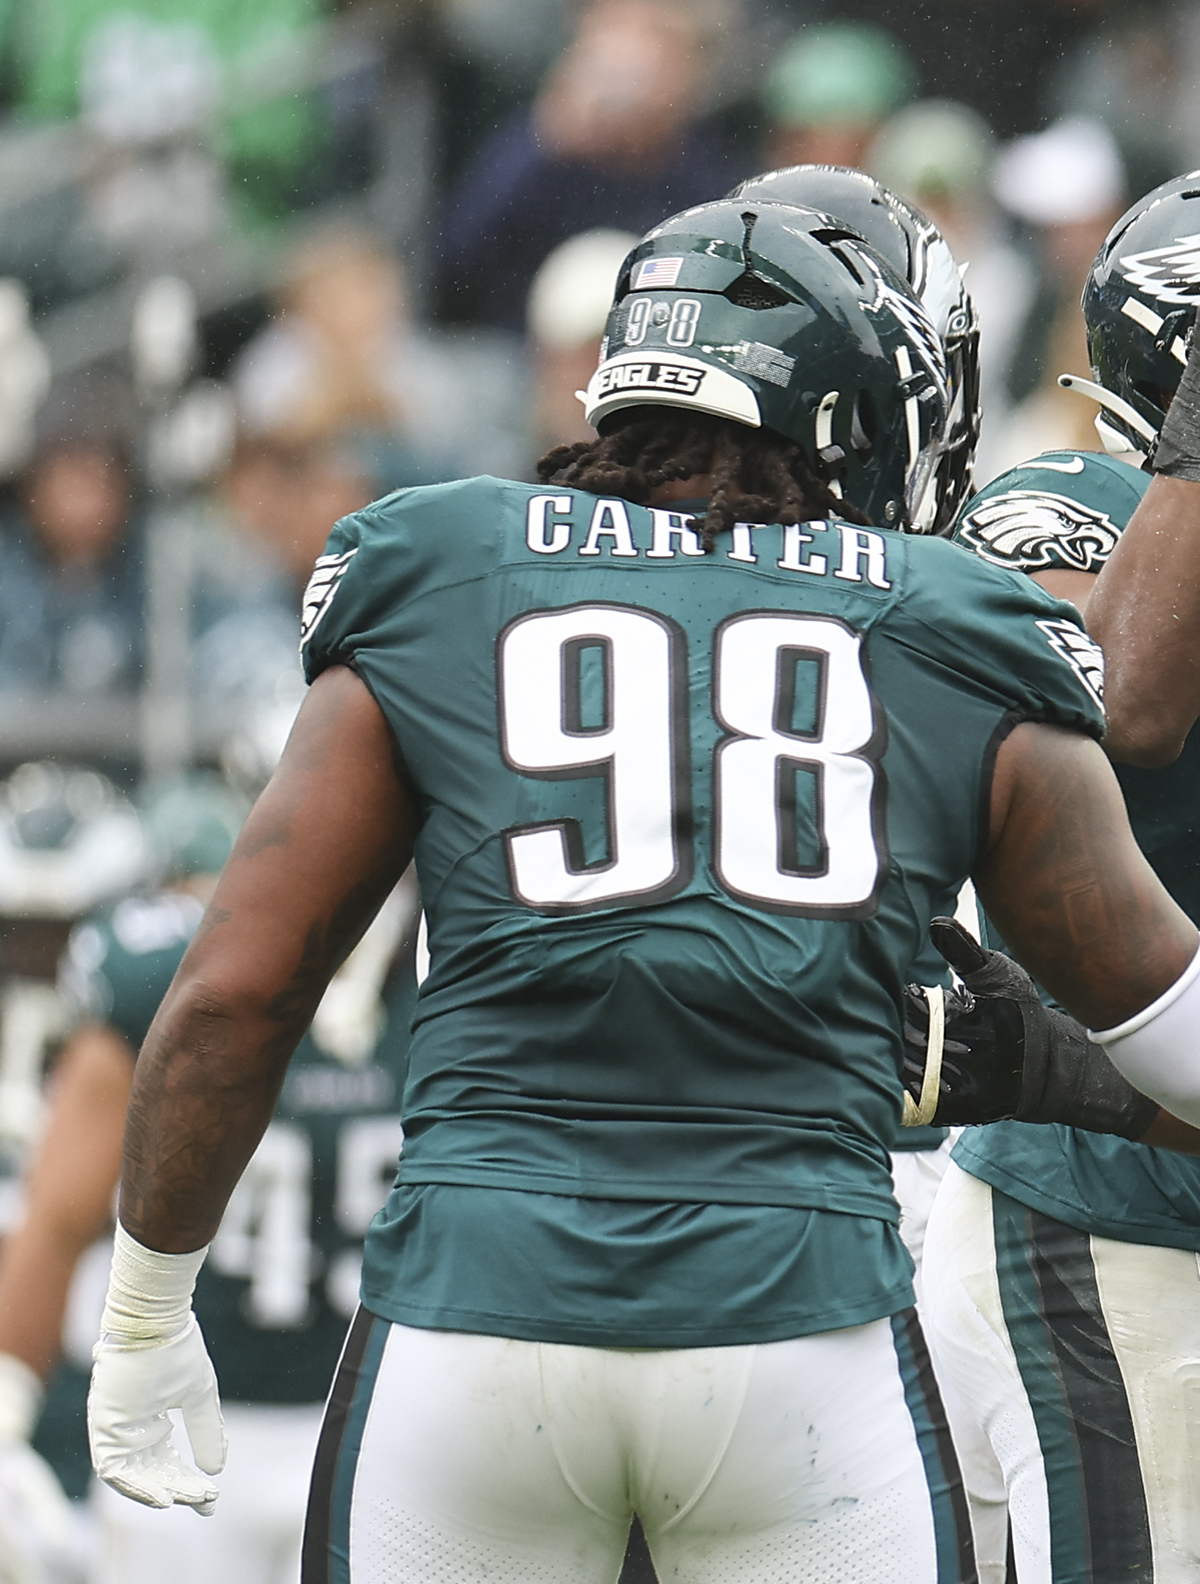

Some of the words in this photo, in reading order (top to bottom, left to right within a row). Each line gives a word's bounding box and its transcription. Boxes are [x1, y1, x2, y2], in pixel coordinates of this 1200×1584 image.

[624, 298, 701, 348] 98
[600, 364, 704, 393] EAGLES
[526, 494, 892, 590] CARTER
[498, 602, 888, 916] 98
